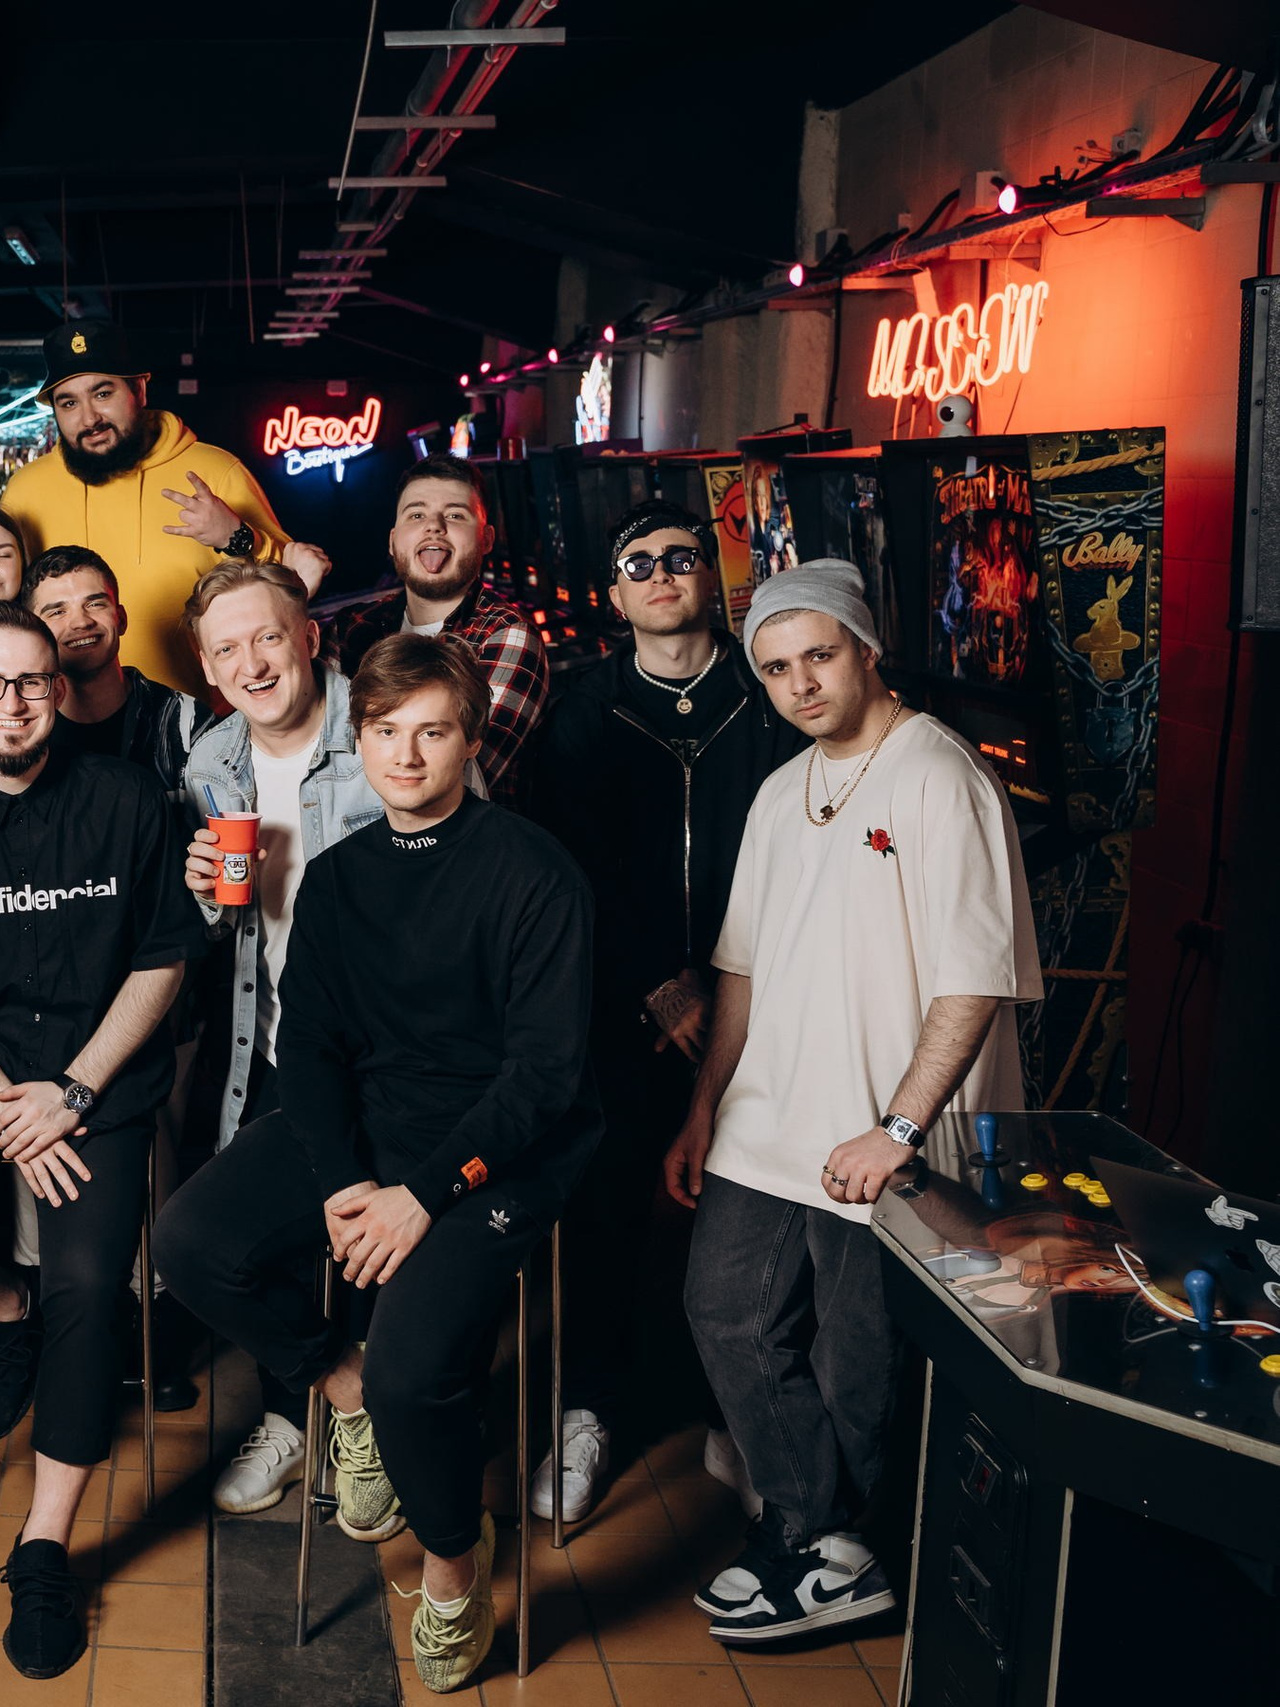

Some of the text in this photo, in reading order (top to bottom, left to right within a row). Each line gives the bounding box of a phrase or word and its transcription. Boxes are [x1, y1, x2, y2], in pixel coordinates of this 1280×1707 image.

[867, 280, 1049, 403] MOSCOW
[263, 397, 381, 456] NEON
[1062, 531, 1144, 573] Bally
[391, 836, 438, 850] СТИЛЬ
